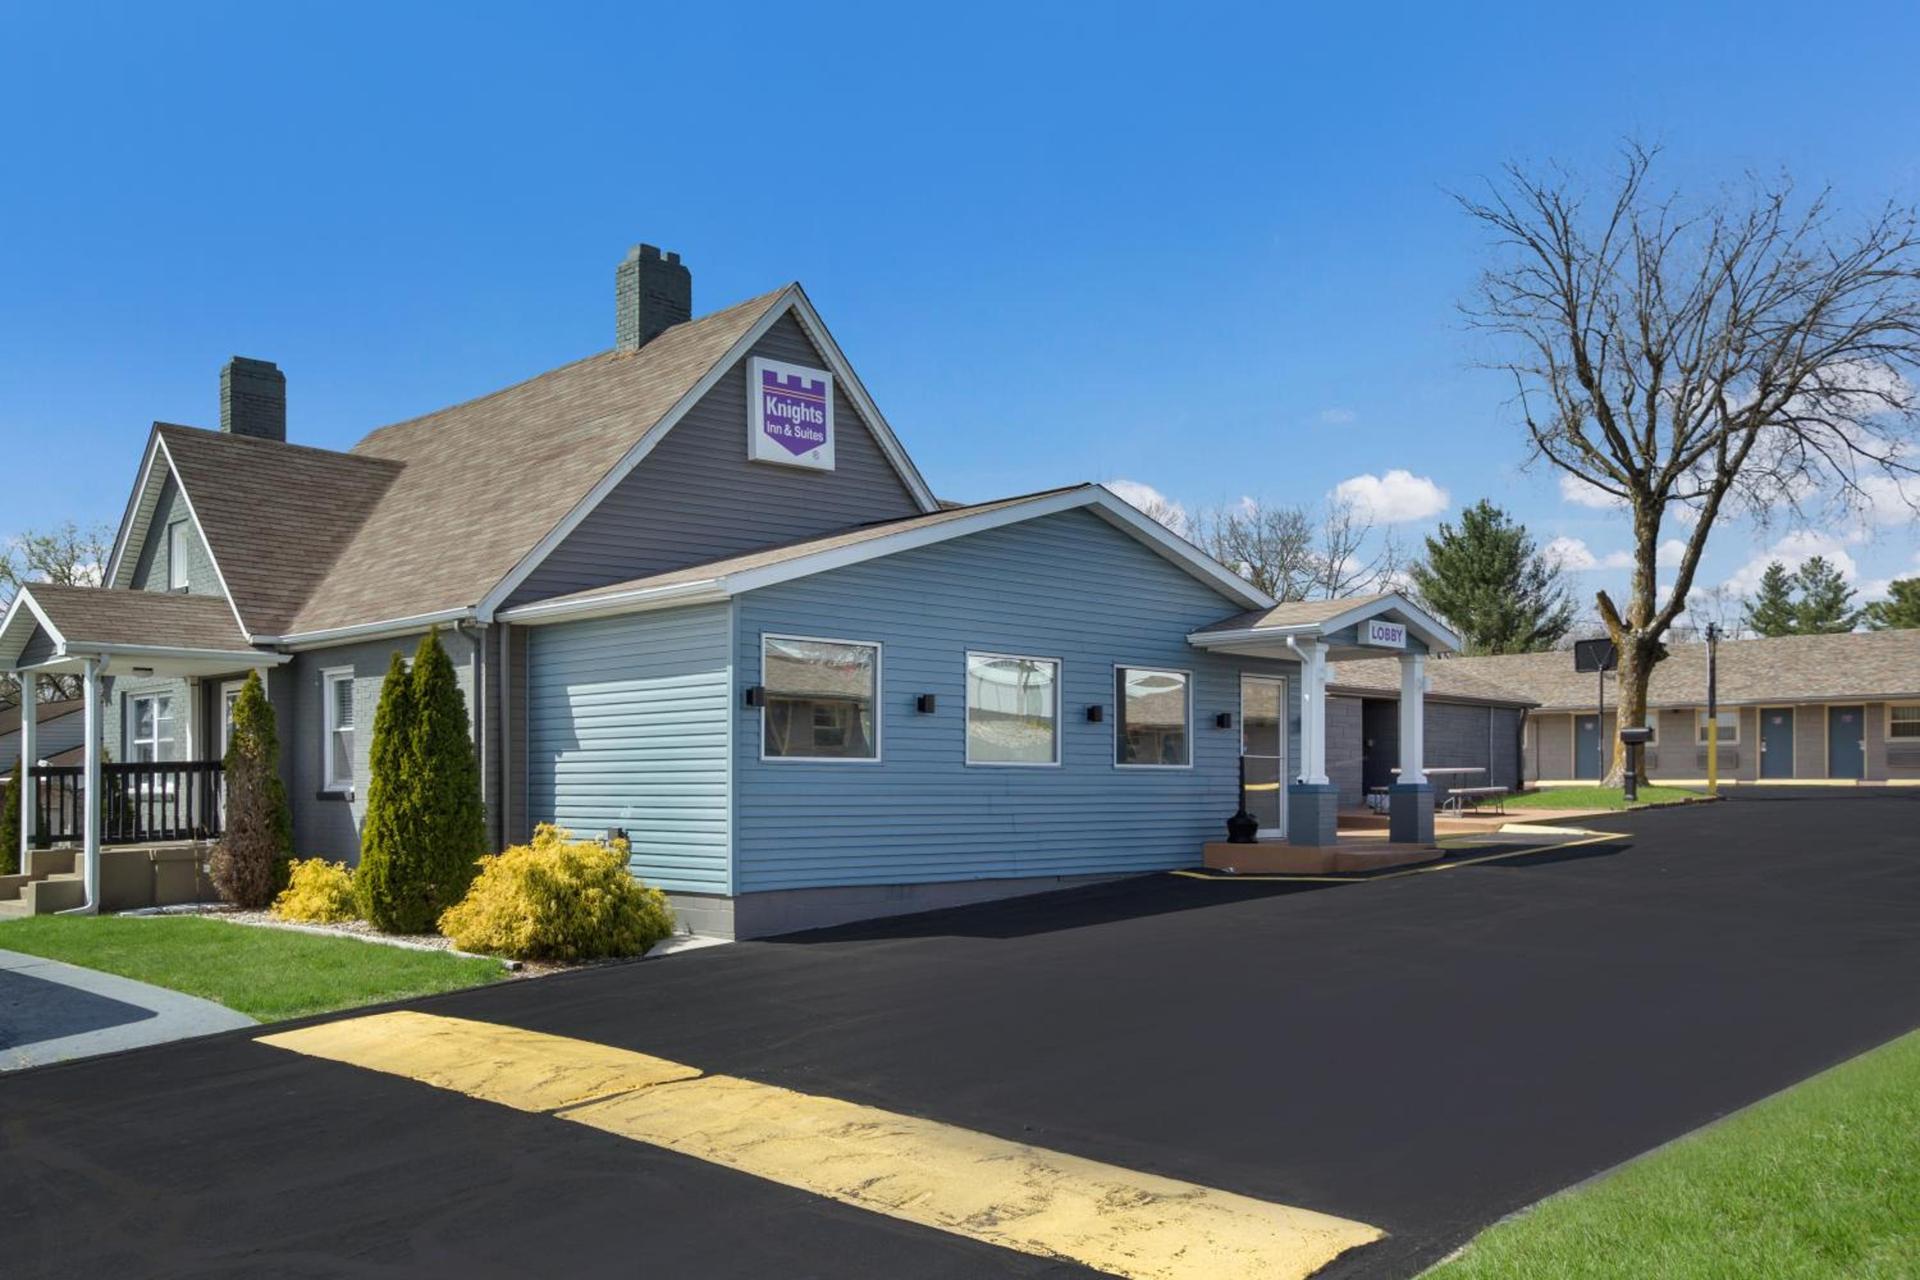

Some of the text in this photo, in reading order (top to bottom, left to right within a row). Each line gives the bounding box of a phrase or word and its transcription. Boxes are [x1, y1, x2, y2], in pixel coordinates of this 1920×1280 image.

[766, 395, 824, 424] Knights
[767, 421, 824, 442] Inn & Suites
[1372, 626, 1403, 642] LOBBY
